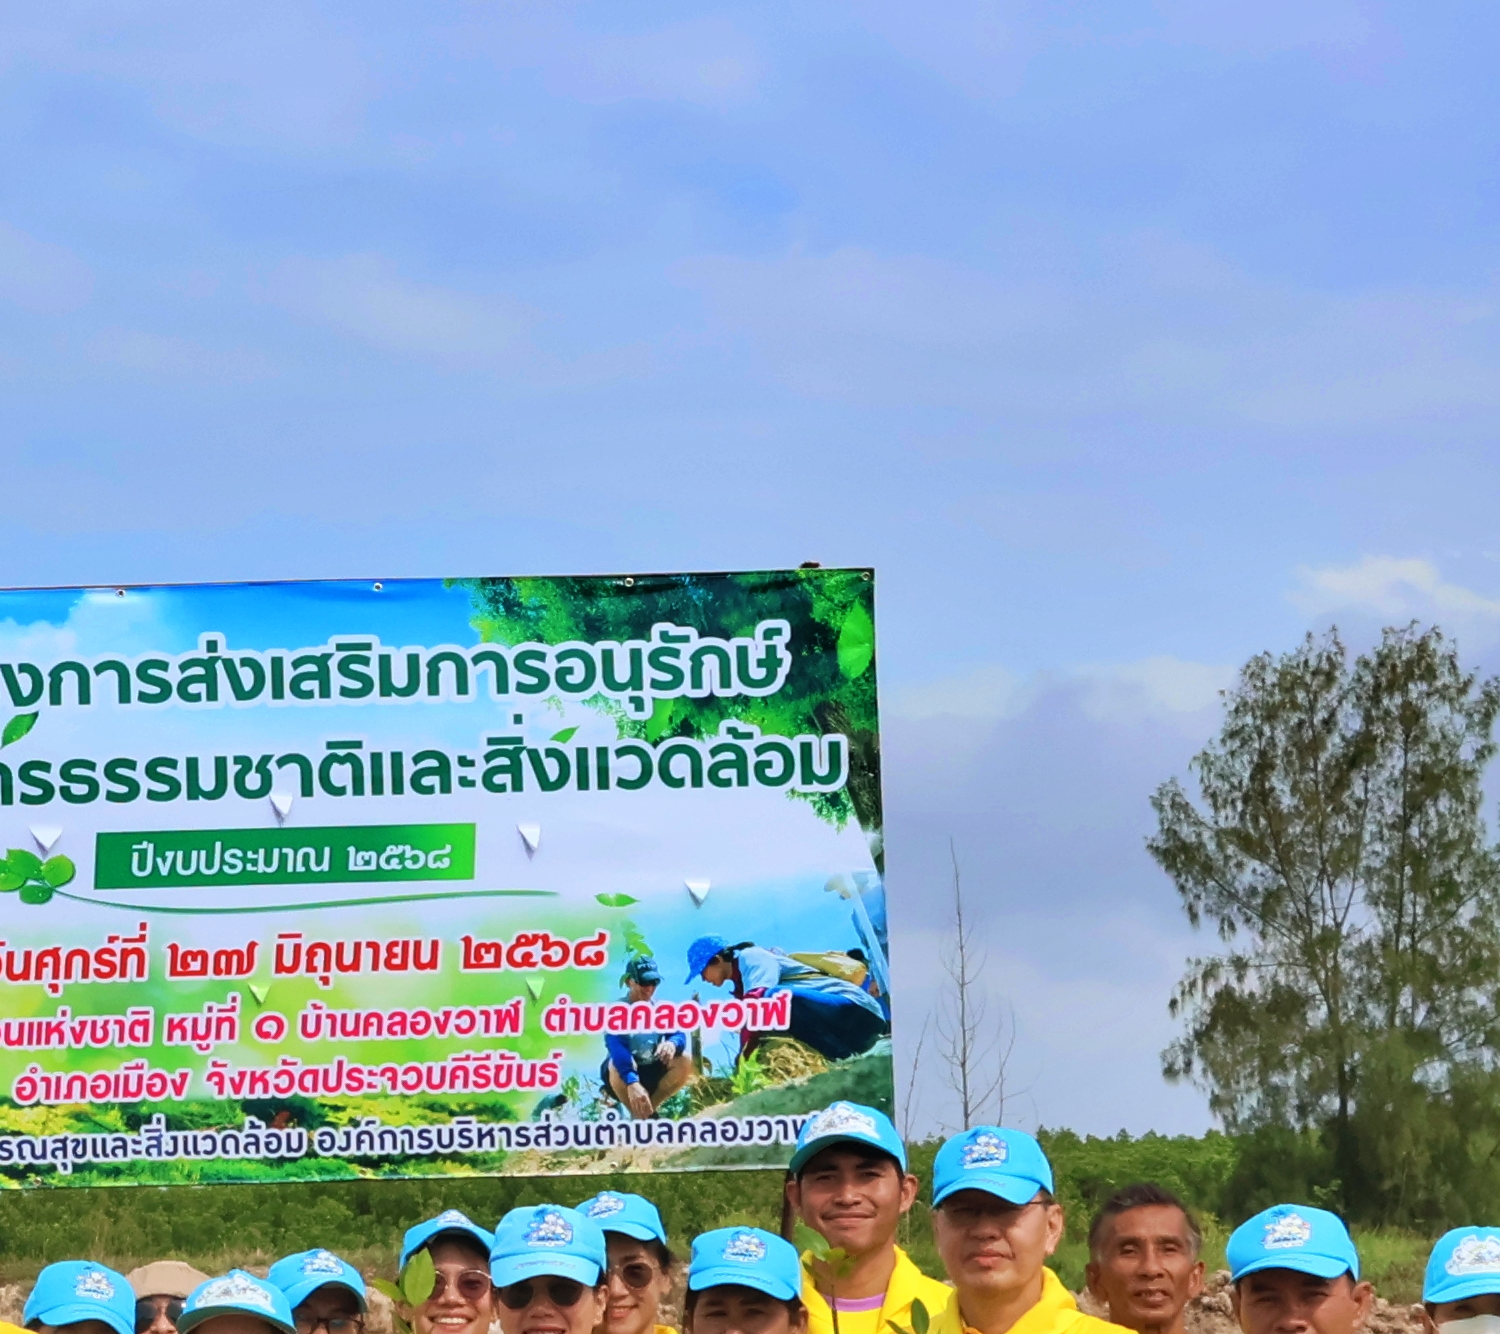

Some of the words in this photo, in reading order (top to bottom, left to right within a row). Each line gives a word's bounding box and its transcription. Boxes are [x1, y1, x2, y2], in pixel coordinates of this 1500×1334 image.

[131, 841, 331, 877] ปีงบประมาณ
[347, 842, 452, 871] ๒๕๖๘
[167, 941, 259, 979] ๒๗
[274, 933, 439, 986] มิถุนายน
[462, 931, 609, 971] ๒๕๖๘
[167, 997, 238, 1051] หมู่ที่
[255, 1015, 286, 1040] ๑
[300, 998, 523, 1040] บ้านคลองวาฬ
[543, 993, 790, 1034] ตำบลคลองวาฬ
[14, 1063, 190, 1102] อำเภอเมือง
[206, 1054, 562, 1098] จังหวัดประจวบคีรีขันธ์
